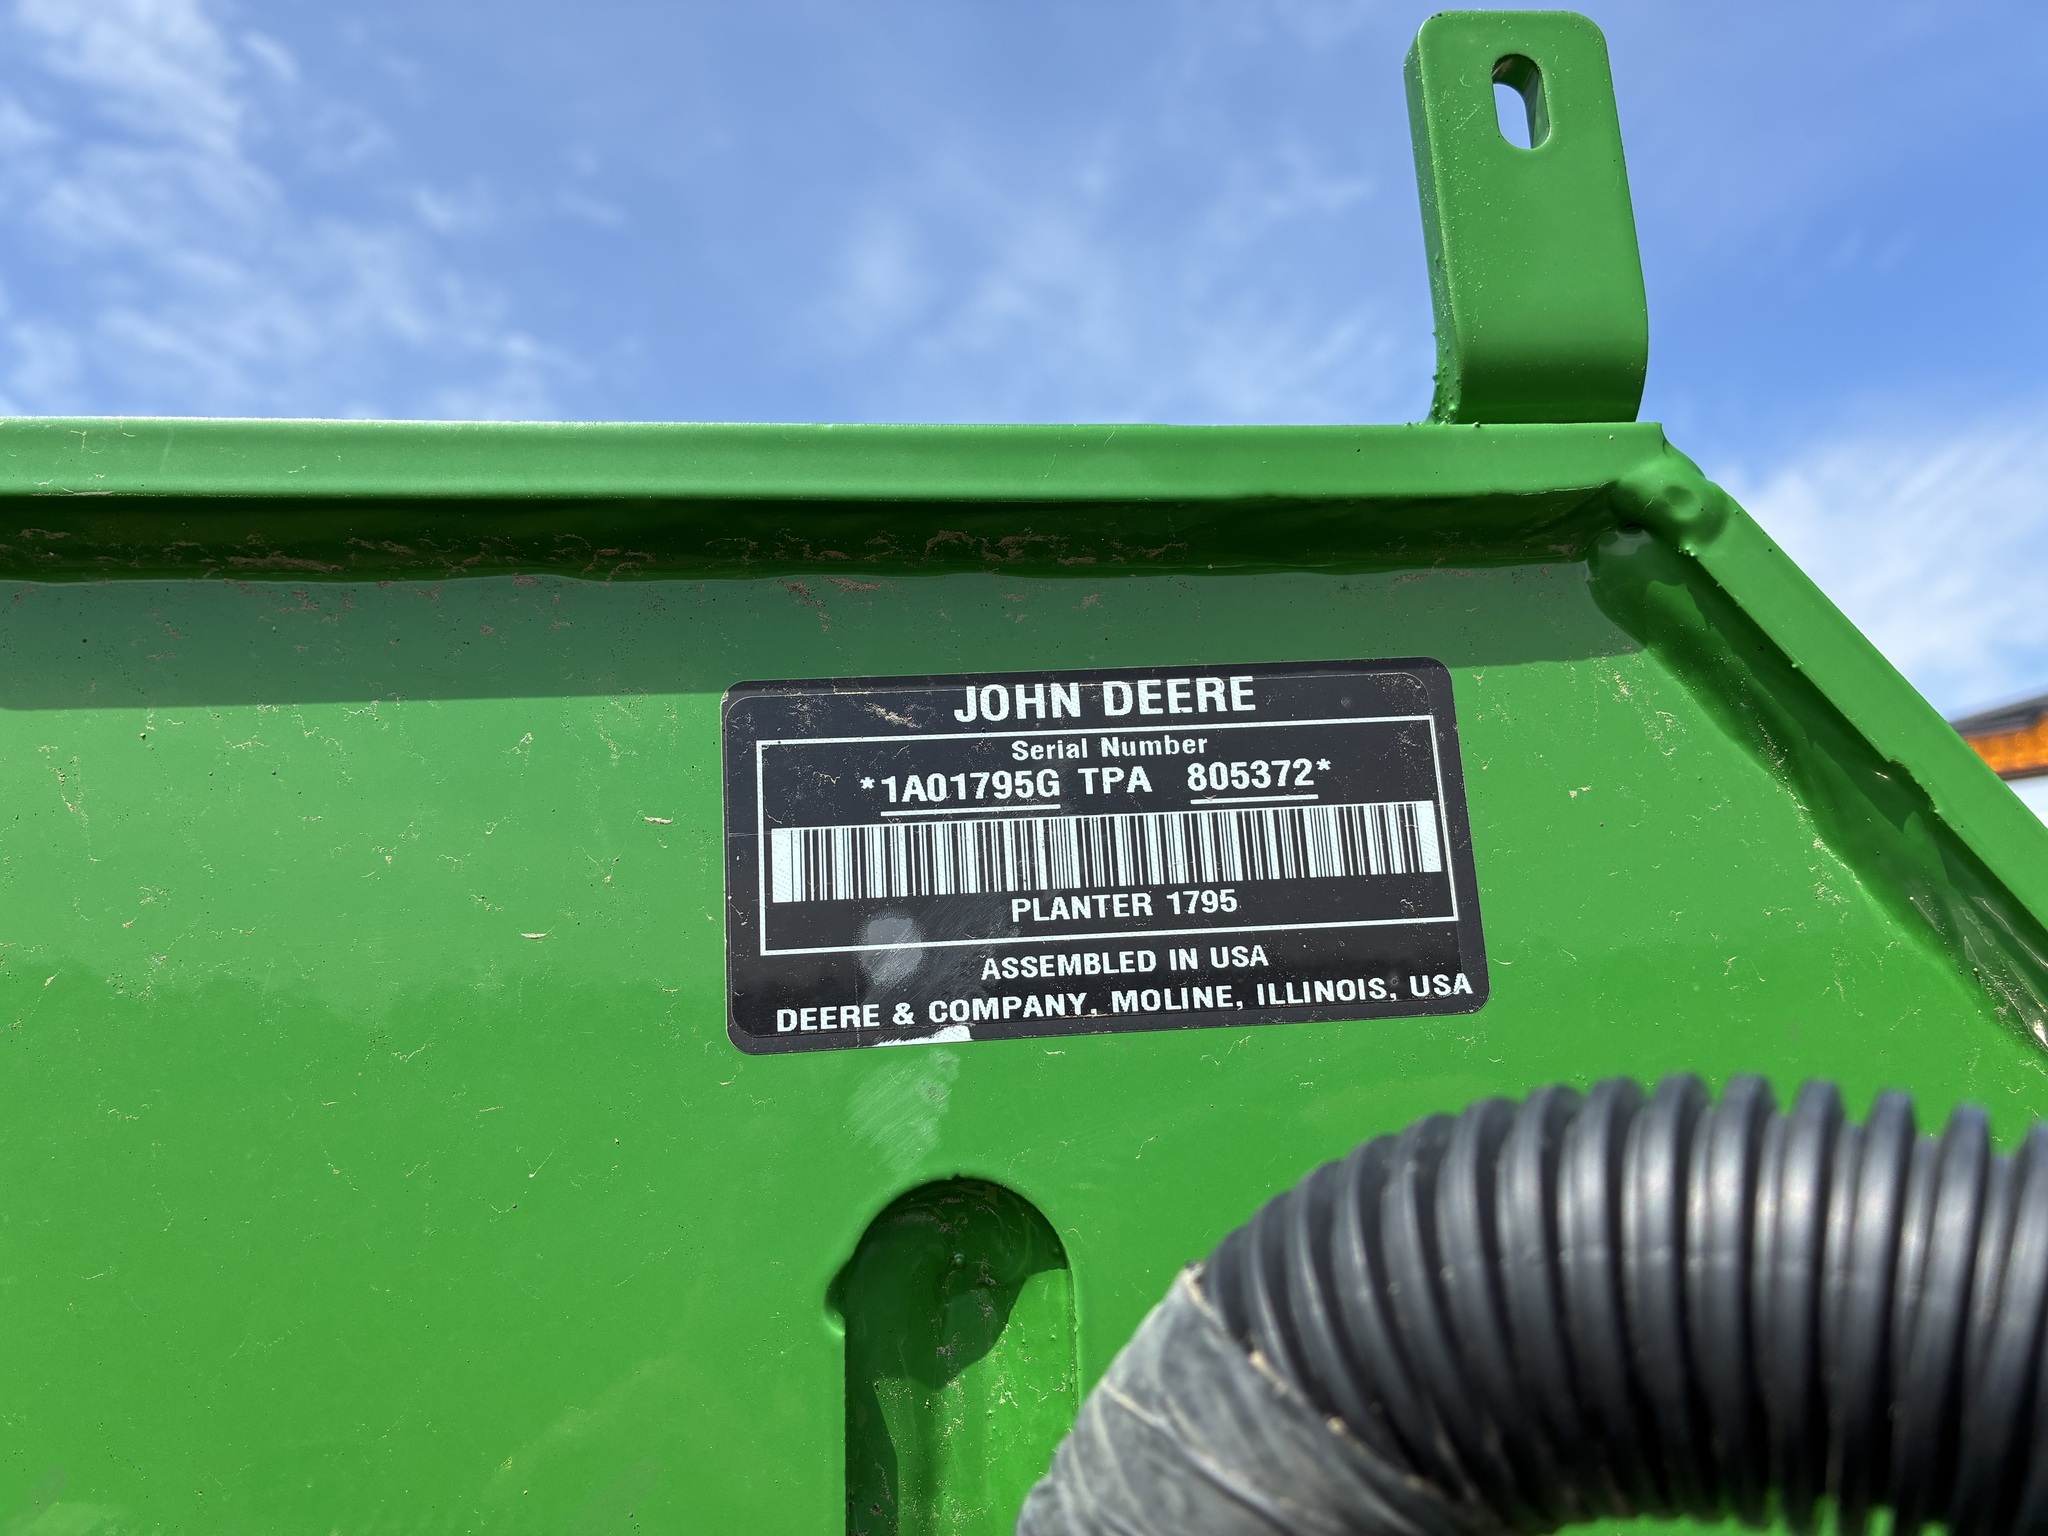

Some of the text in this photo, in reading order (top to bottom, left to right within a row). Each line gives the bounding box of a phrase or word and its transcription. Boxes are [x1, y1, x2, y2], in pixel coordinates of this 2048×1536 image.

[954, 675, 1256, 723] JOHN DEERE
[1011, 735, 1208, 762] Serial Number
[1078, 765, 1153, 795] TPA
[1011, 888, 1238, 923] PLANTER 1795
[980, 944, 1270, 981] ASSEMBLED IN USA
[776, 1003, 881, 1033] DEERE
[892, 1002, 916, 1026] &
[1111, 984, 1244, 1014] MOLINE,
[1256, 977, 1398, 1006] ILLINOIS,
[1409, 972, 1474, 998] USA
